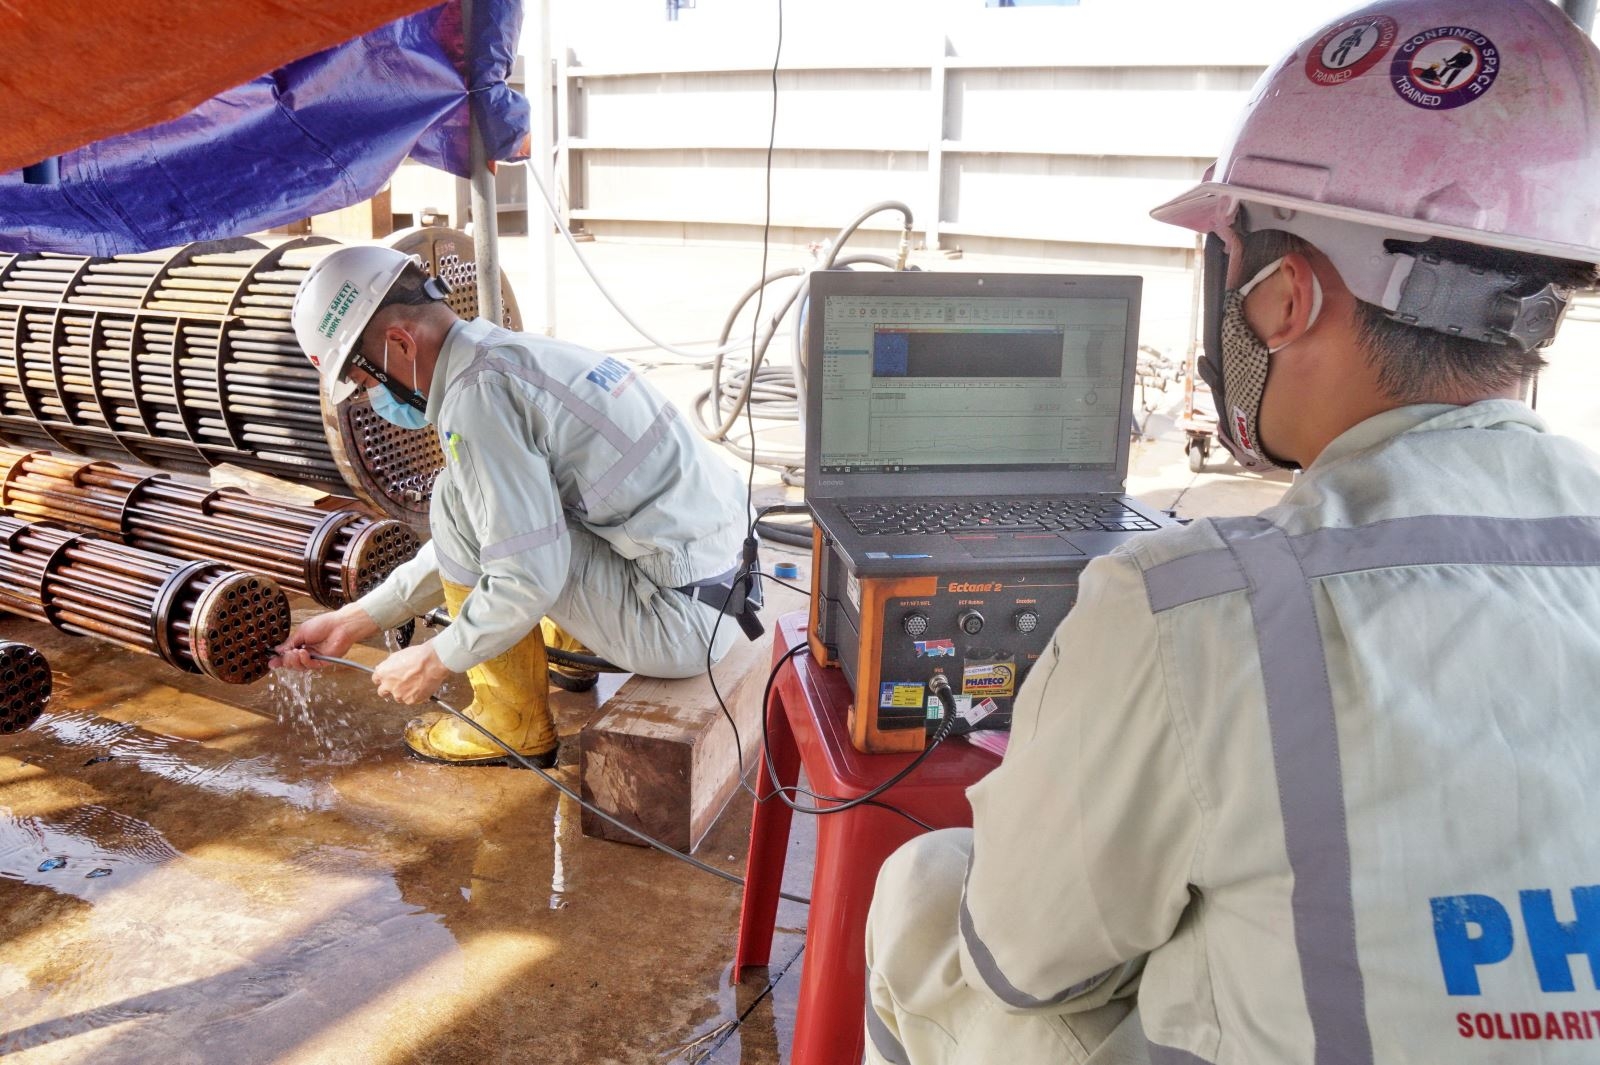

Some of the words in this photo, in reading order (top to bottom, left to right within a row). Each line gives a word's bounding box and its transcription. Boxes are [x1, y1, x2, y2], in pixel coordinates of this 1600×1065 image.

[1311, 69, 1353, 83] TRAINED
[1403, 27, 1487, 53] CONFINED
[1468, 48, 1497, 94] SPACE
[1396, 75, 1442, 106] TRAINED
[319, 311, 334, 333] THINK
[331, 283, 352, 311] SAFETY
[326, 316, 342, 338] WORK
[338, 288, 359, 316] SAFETY
[965, 677, 1005, 686] PHATECO
